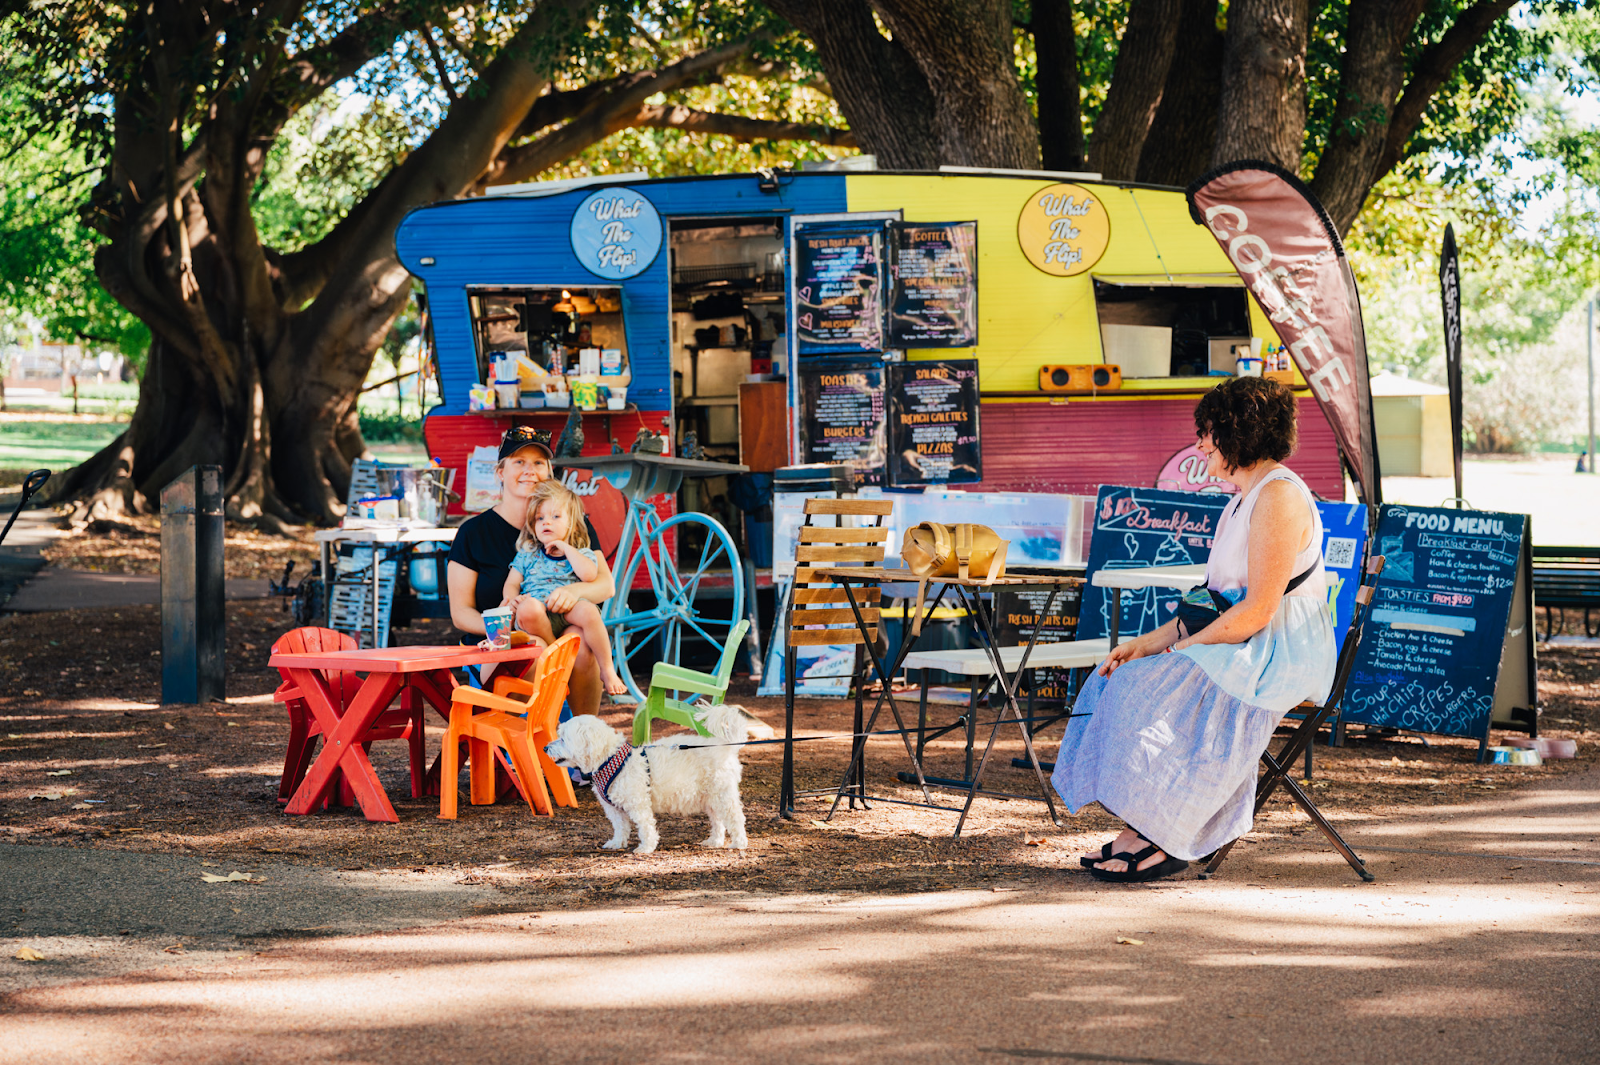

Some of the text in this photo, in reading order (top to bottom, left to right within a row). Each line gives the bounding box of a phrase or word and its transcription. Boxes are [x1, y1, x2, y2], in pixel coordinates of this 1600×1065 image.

[589, 197, 645, 220] What
[1039, 194, 1094, 216] What
[602, 221, 634, 245] The
[1049, 218, 1081, 240] The
[598, 244, 637, 273] Flip!
[1044, 241, 1082, 270] Flip!
[1205, 204, 1351, 403] COFFEE
[820, 374, 866, 386] TOASTIES
[916, 368, 949, 379] SALADS
[824, 427, 866, 438] BURGERS
[917, 442, 954, 454] PIZZAS
[1126, 506, 1212, 541] Breakfast
[1405, 512, 1504, 535] FOOD MENU
[1422, 533, 1492, 550] Breakfast deal
[1430, 549, 1456, 558] Coffee
[1429, 558, 1446, 566] Ham
[1446, 559, 1452, 567] &
[1453, 561, 1478, 570] cheese
[1428, 570, 1450, 579] Bacon
[1450, 571, 1456, 579] &
[1381, 587, 1430, 603] TOASTIES
[1384, 602, 1399, 611] Ham
[1378, 631, 1406, 639] Chicken
[1421, 634, 1427, 642] &
[1375, 647, 1437, 664] Tomato & cheese
[1404, 644, 1419, 654] egg
[1421, 644, 1428, 653] &
[1429, 646, 1452, 656] cheese
[1373, 658, 1403, 670] Avocado
[1403, 663, 1422, 672] Mash
[1037, 686, 1067, 698] POLES
[1402, 680, 1454, 727] CREPES
[1450, 694, 1494, 733] SALAD
